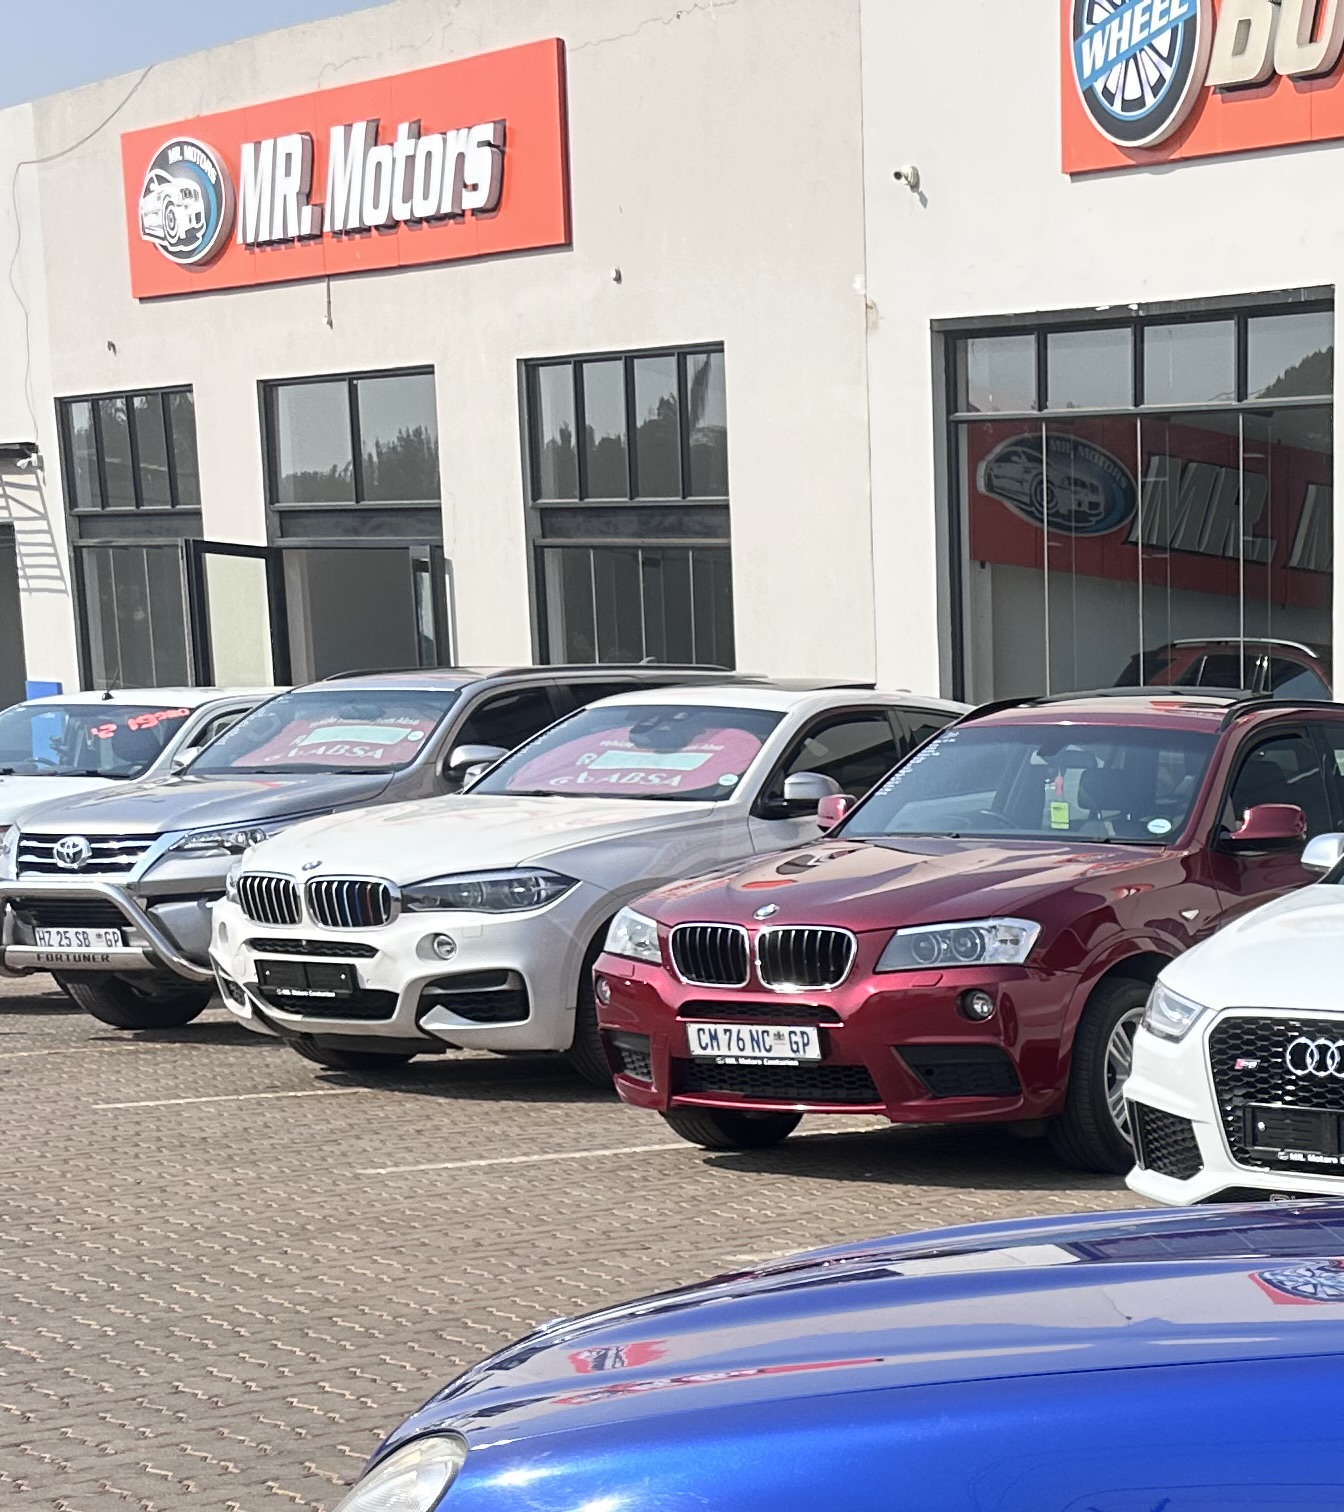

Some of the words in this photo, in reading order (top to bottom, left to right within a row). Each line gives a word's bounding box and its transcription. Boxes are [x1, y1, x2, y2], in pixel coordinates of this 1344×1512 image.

[183, 144, 218, 185] MOTORS
[236, 133, 321, 245] MR.
[323, 119, 502, 234] Motors
[1077, 444, 1129, 489] MOTORS
[1128, 454, 1278, 565] MR.
[304, 743, 385, 760] ABSA
[598, 771, 682, 787] ABSA
[56, 930, 72, 947] 25
[104, 931, 120, 948] GP
[37, 953, 111, 963] FORTUNER
[697, 1027, 720, 1051] CM
[723, 1028, 746, 1052] 76
[749, 1029, 773, 1053] NC
[788, 1030, 810, 1054] GP
[1308, 1154, 1338, 1164] Motors
